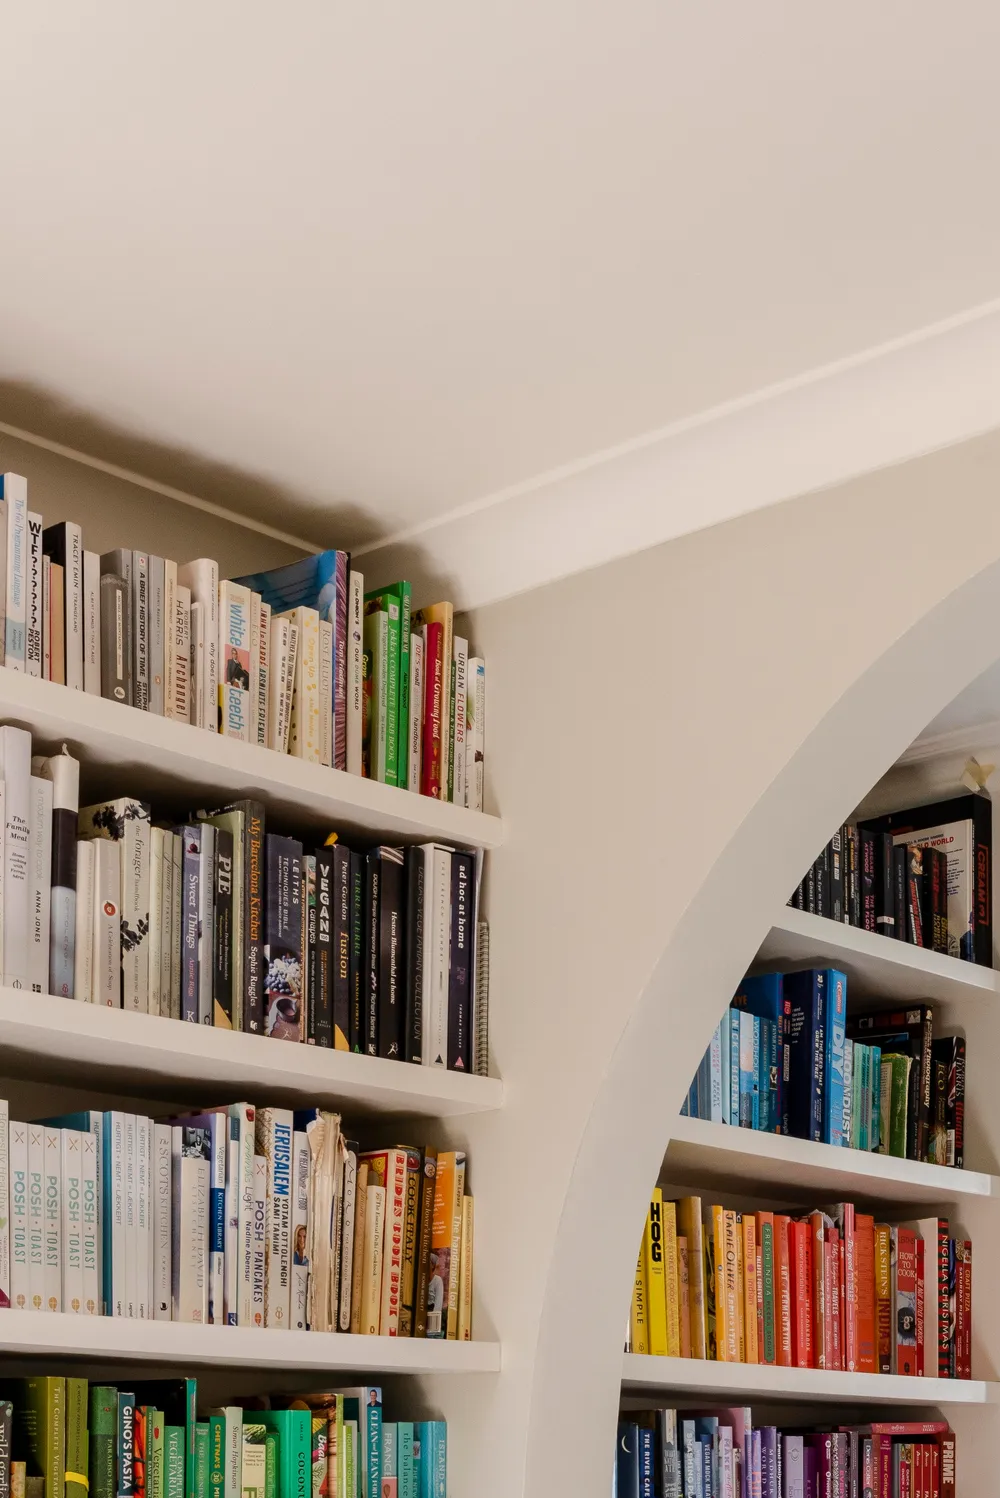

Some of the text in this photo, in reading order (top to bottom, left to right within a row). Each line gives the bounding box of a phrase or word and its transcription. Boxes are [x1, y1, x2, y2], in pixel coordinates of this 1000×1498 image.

[175, 600, 184, 646] HARRIS
[229, 604, 246, 647] white
[140, 644, 146, 655] OF
[175, 655, 188, 716] Archangel
[229, 688, 244, 730] teeth
[456, 693, 464, 743] FLOWERS
[6, 822, 30, 835] Family
[10, 832, 27, 842] Meal
[12, 815, 27, 825] The
[931, 836, 955, 847] WORLD
[218, 854, 232, 895] PIE
[292, 858, 300, 905] LEITHS
[320, 863, 330, 932] VEGAN
[459, 865, 466, 883] ad
[186, 874, 199, 950] Sweet Things
[247, 817, 261, 1007] My Barcelona Kitchen Sophie Ruggles
[340, 886, 348, 921] Gordon
[458, 905, 465, 915] at
[340, 932, 349, 979] fusion
[457, 917, 465, 949] home
[831, 1025, 844, 1085] DIY
[842, 1044, 853, 1142] MOONDUST
[274, 1122, 291, 1196] JERUSALEM
[14, 1171, 26, 1264] POSH TOAST
[31, 1173, 42, 1265] POSH TOAST
[46, 1175, 58, 1268] POSH TOAST
[68, 1177, 80, 1269] POSH TOAST
[84, 1180, 95, 1270] POSH TOAST
[389, 1154, 405, 1317] BRIDES COOK BOOK
[405, 1177, 416, 1264] COOK ITALY
[650, 1202, 662, 1263] HOG
[254, 1200, 265, 1303] POSH PANCAKES
[280, 1225, 289, 1287] OTTOLENGHI
[452, 1234, 462, 1288] handmade
[725, 1212, 736, 1290] JAMIE OLIVER
[898, 1270, 915, 1278] COOK
[880, 1257, 888, 1296] STEIN'S
[449, 1291, 457, 1311] loaf
[878, 1298, 890, 1340] INDIA
[122, 1406, 133, 1490] GINO'S PASTA
[230, 1451, 239, 1490] Hopkinson
[943, 1441, 954, 1484] PRIME
[401, 1453, 410, 1497] balance
